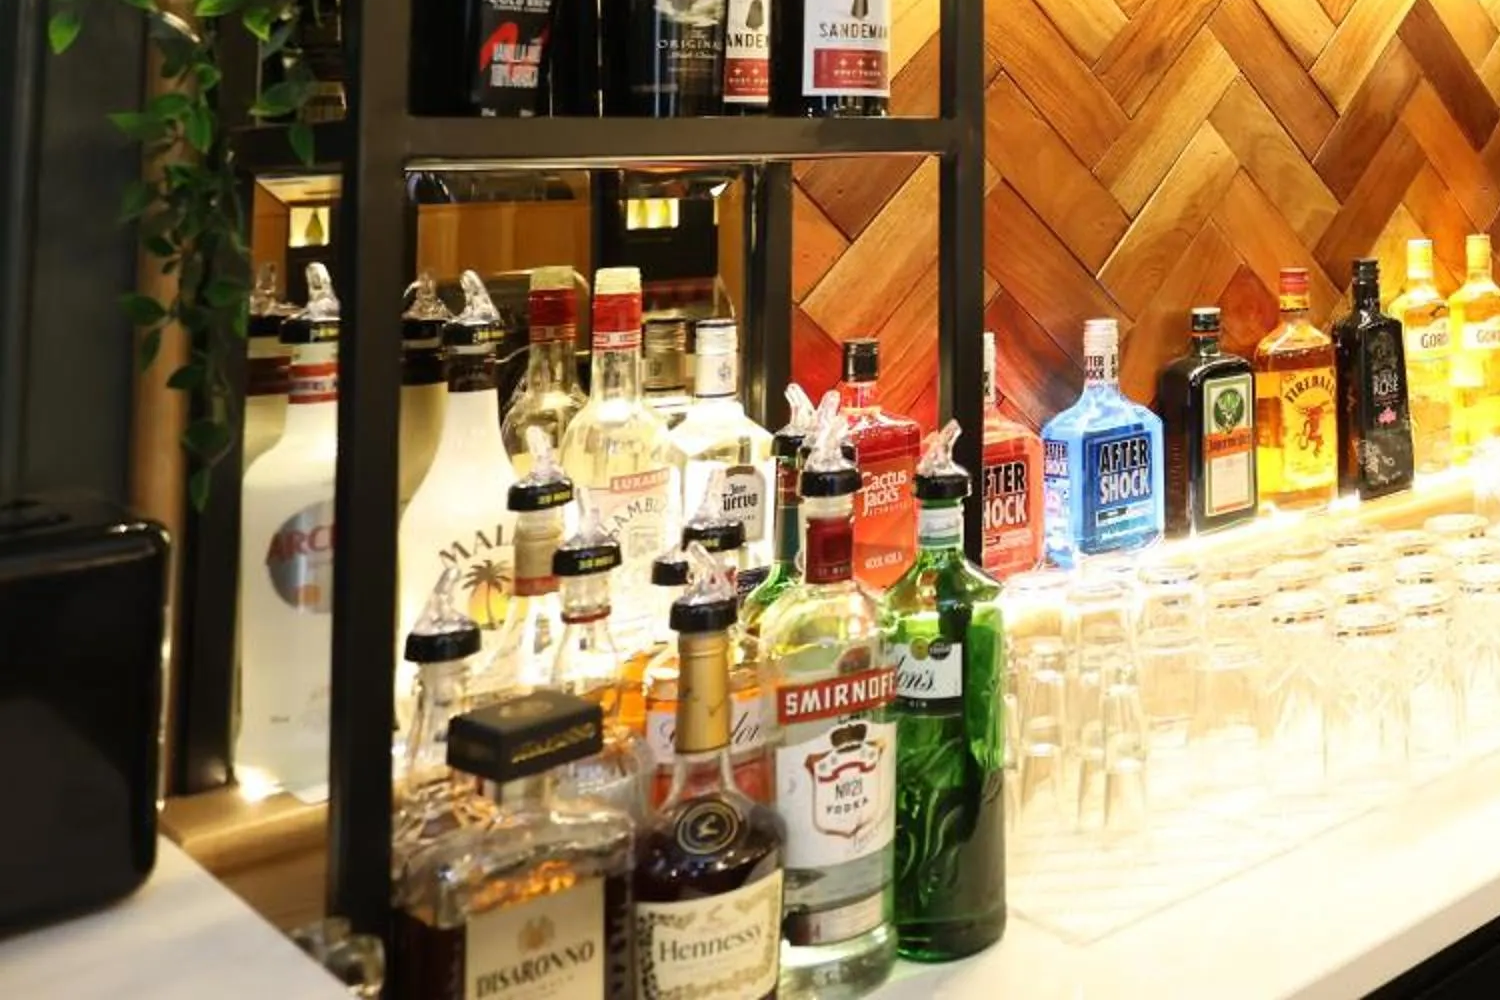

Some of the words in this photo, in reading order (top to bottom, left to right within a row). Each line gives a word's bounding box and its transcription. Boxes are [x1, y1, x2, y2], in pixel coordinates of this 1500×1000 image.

[727, 34, 769, 49] ANDE
[1101, 438, 1149, 474] AFTER
[1101, 467, 1150, 505] SHOCK
[785, 671, 896, 716] SMIRNOFF
[826, 796, 870, 815] VODKA
[659, 924, 762, 964] Hennessy
[475, 941, 596, 999] DISARONNO
